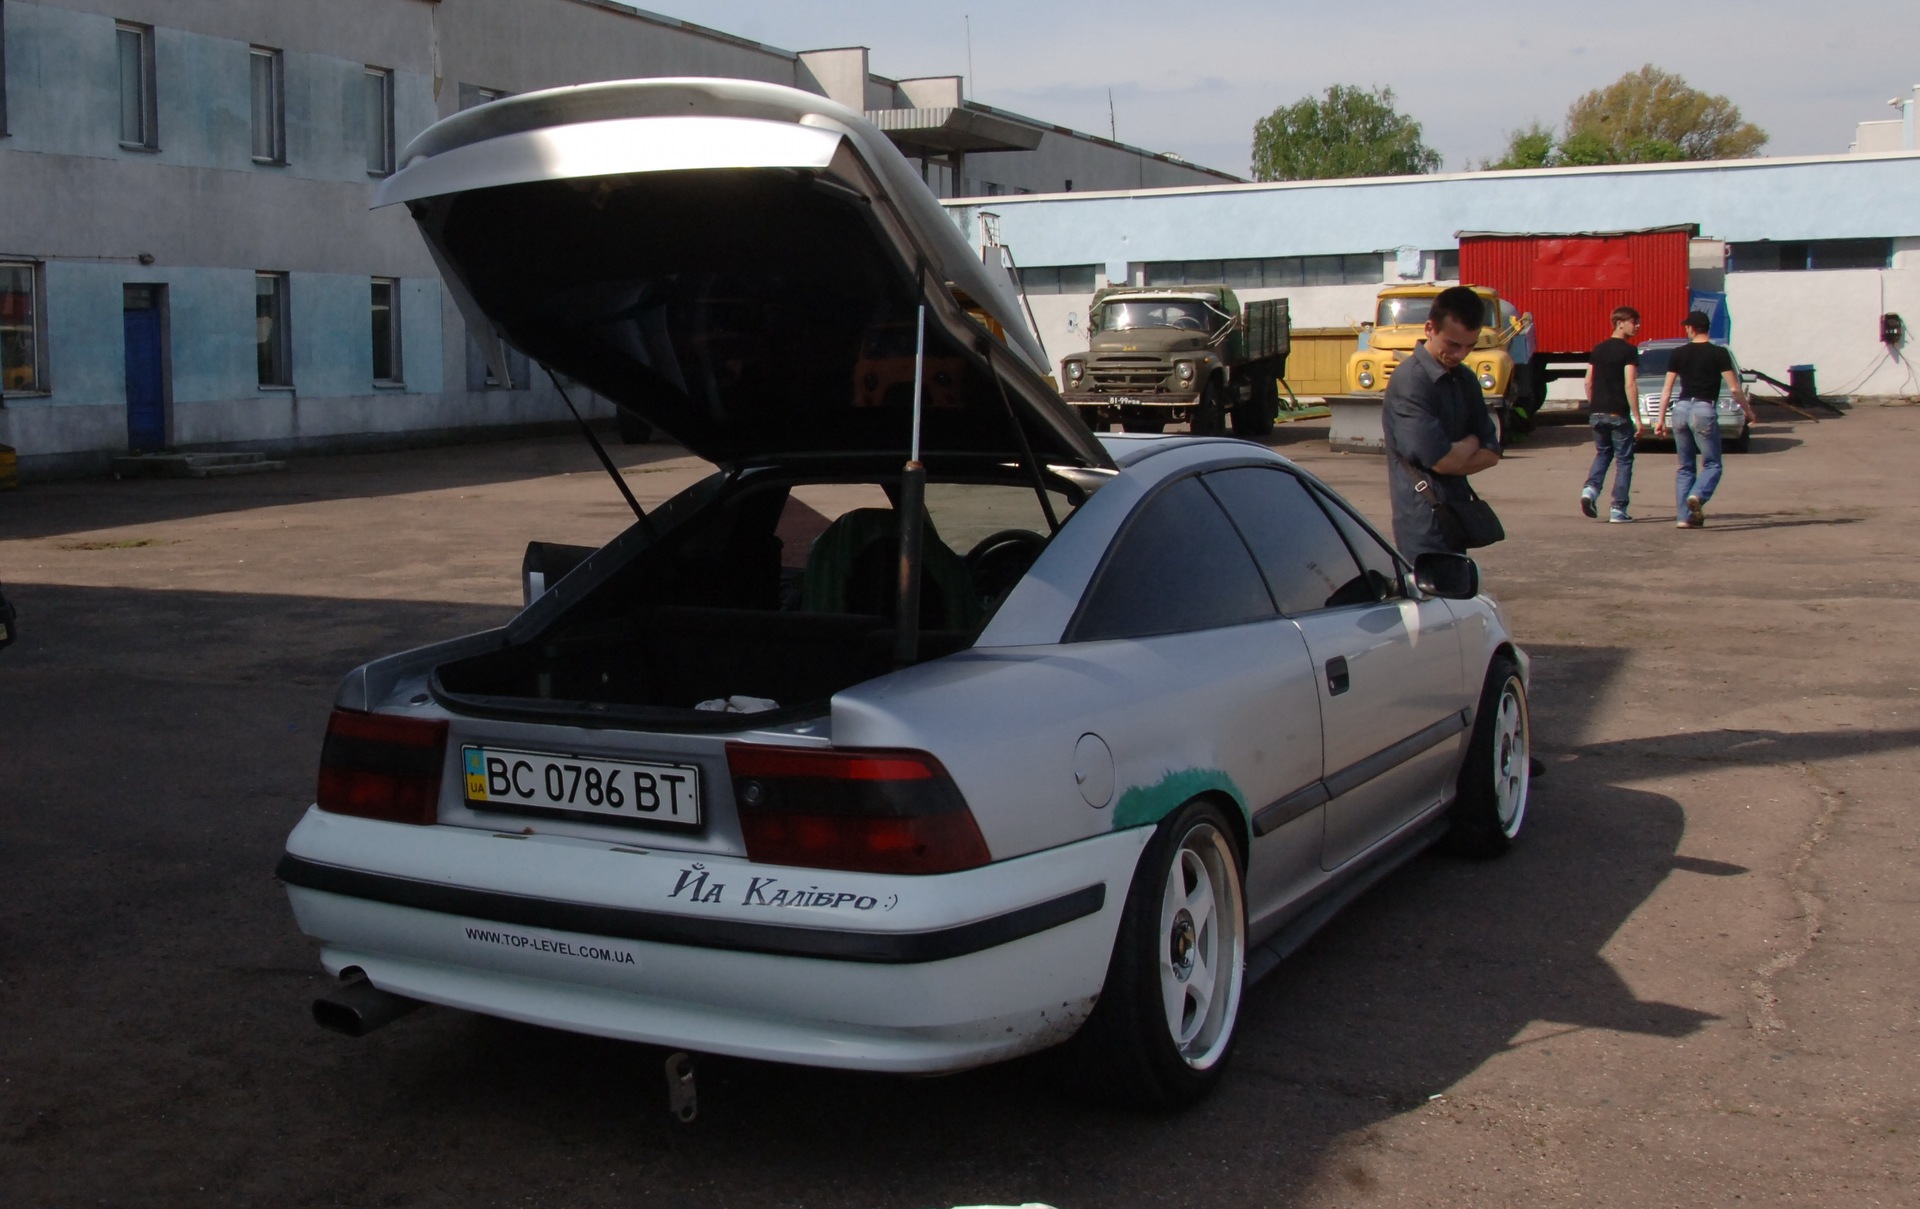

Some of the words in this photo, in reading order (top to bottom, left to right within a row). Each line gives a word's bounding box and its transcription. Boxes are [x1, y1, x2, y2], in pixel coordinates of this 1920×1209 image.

[470, 782, 486, 794] UA
[486, 756, 535, 798] BC
[544, 763, 625, 808] 0786
[634, 771, 685, 815] BT
[465, 927, 635, 965] WWW.TOP-LEVEL.COM.UA
